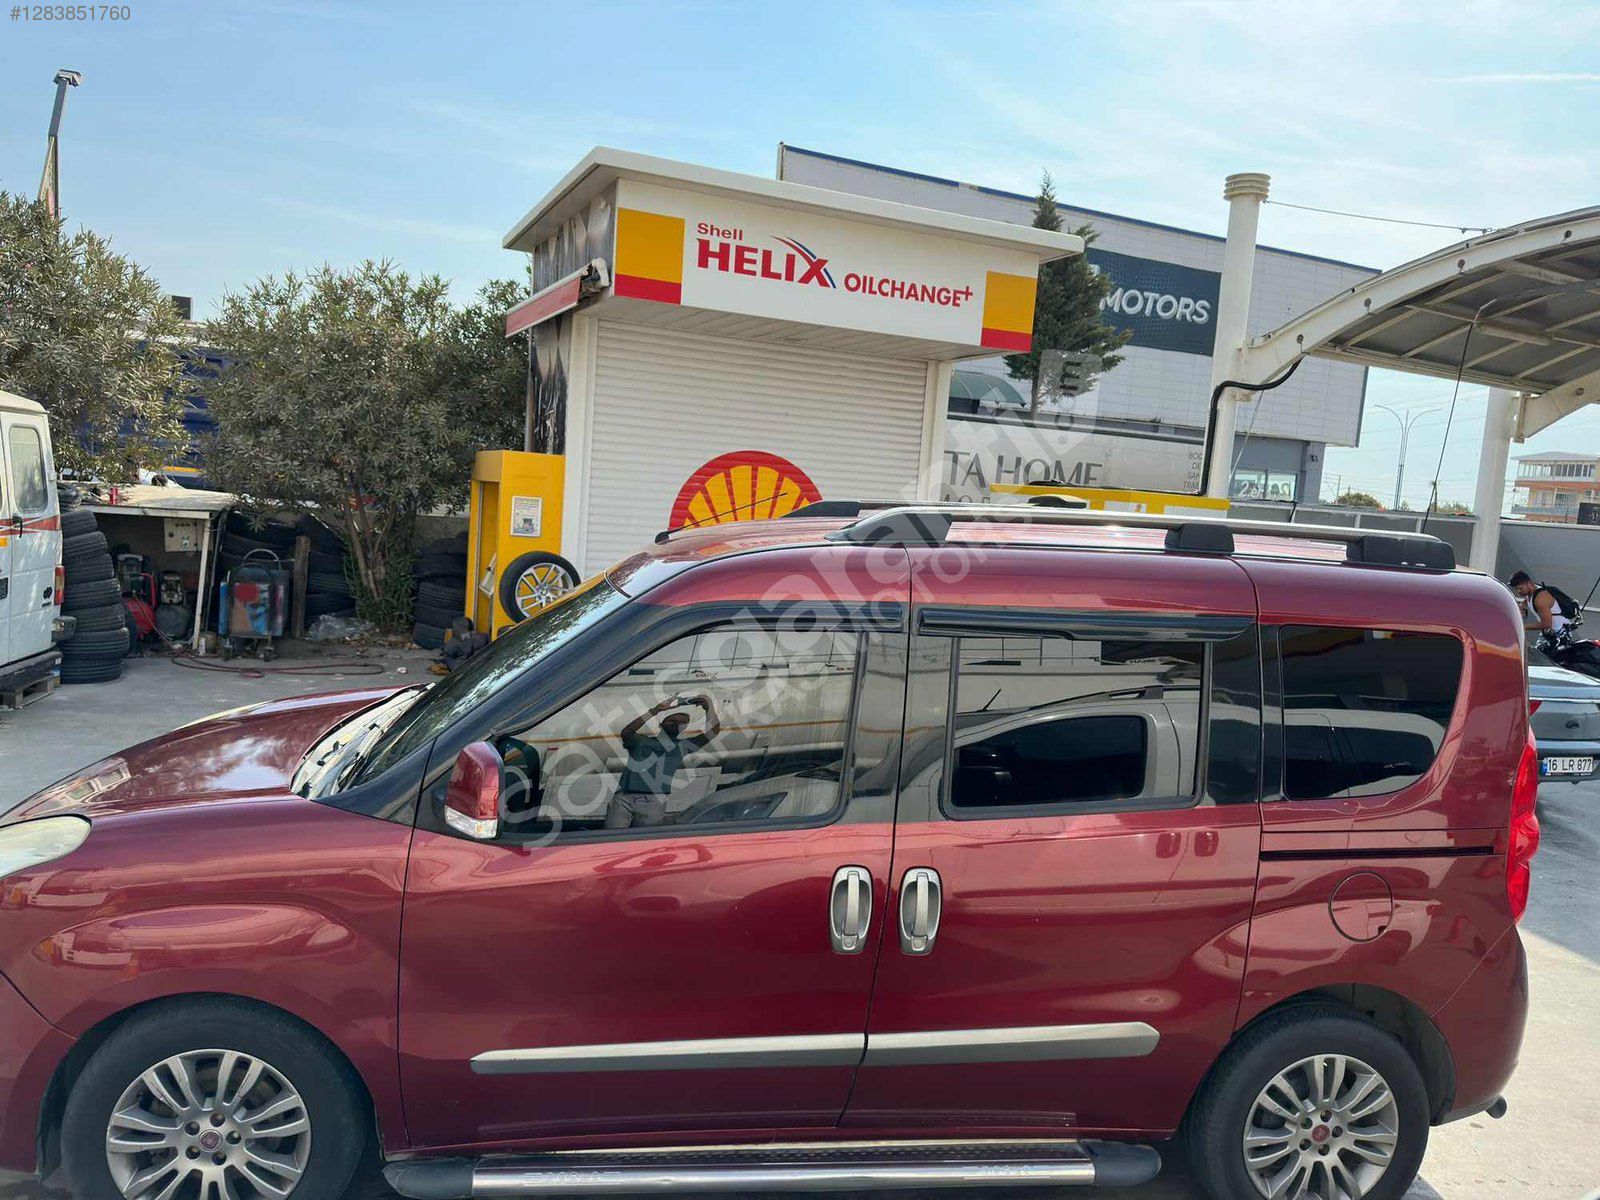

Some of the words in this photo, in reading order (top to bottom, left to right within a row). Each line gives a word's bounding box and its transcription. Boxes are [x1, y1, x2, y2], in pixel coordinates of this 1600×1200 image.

[697, 222, 744, 242] Shell
[696, 235, 836, 289] HELIX
[1098, 287, 1211, 325] MOTORS
[995, 455, 1102, 486] HOME
[1548, 758, 1558, 771] 16
[1561, 758, 1576, 771] LR
[1577, 758, 1592, 771] 877
